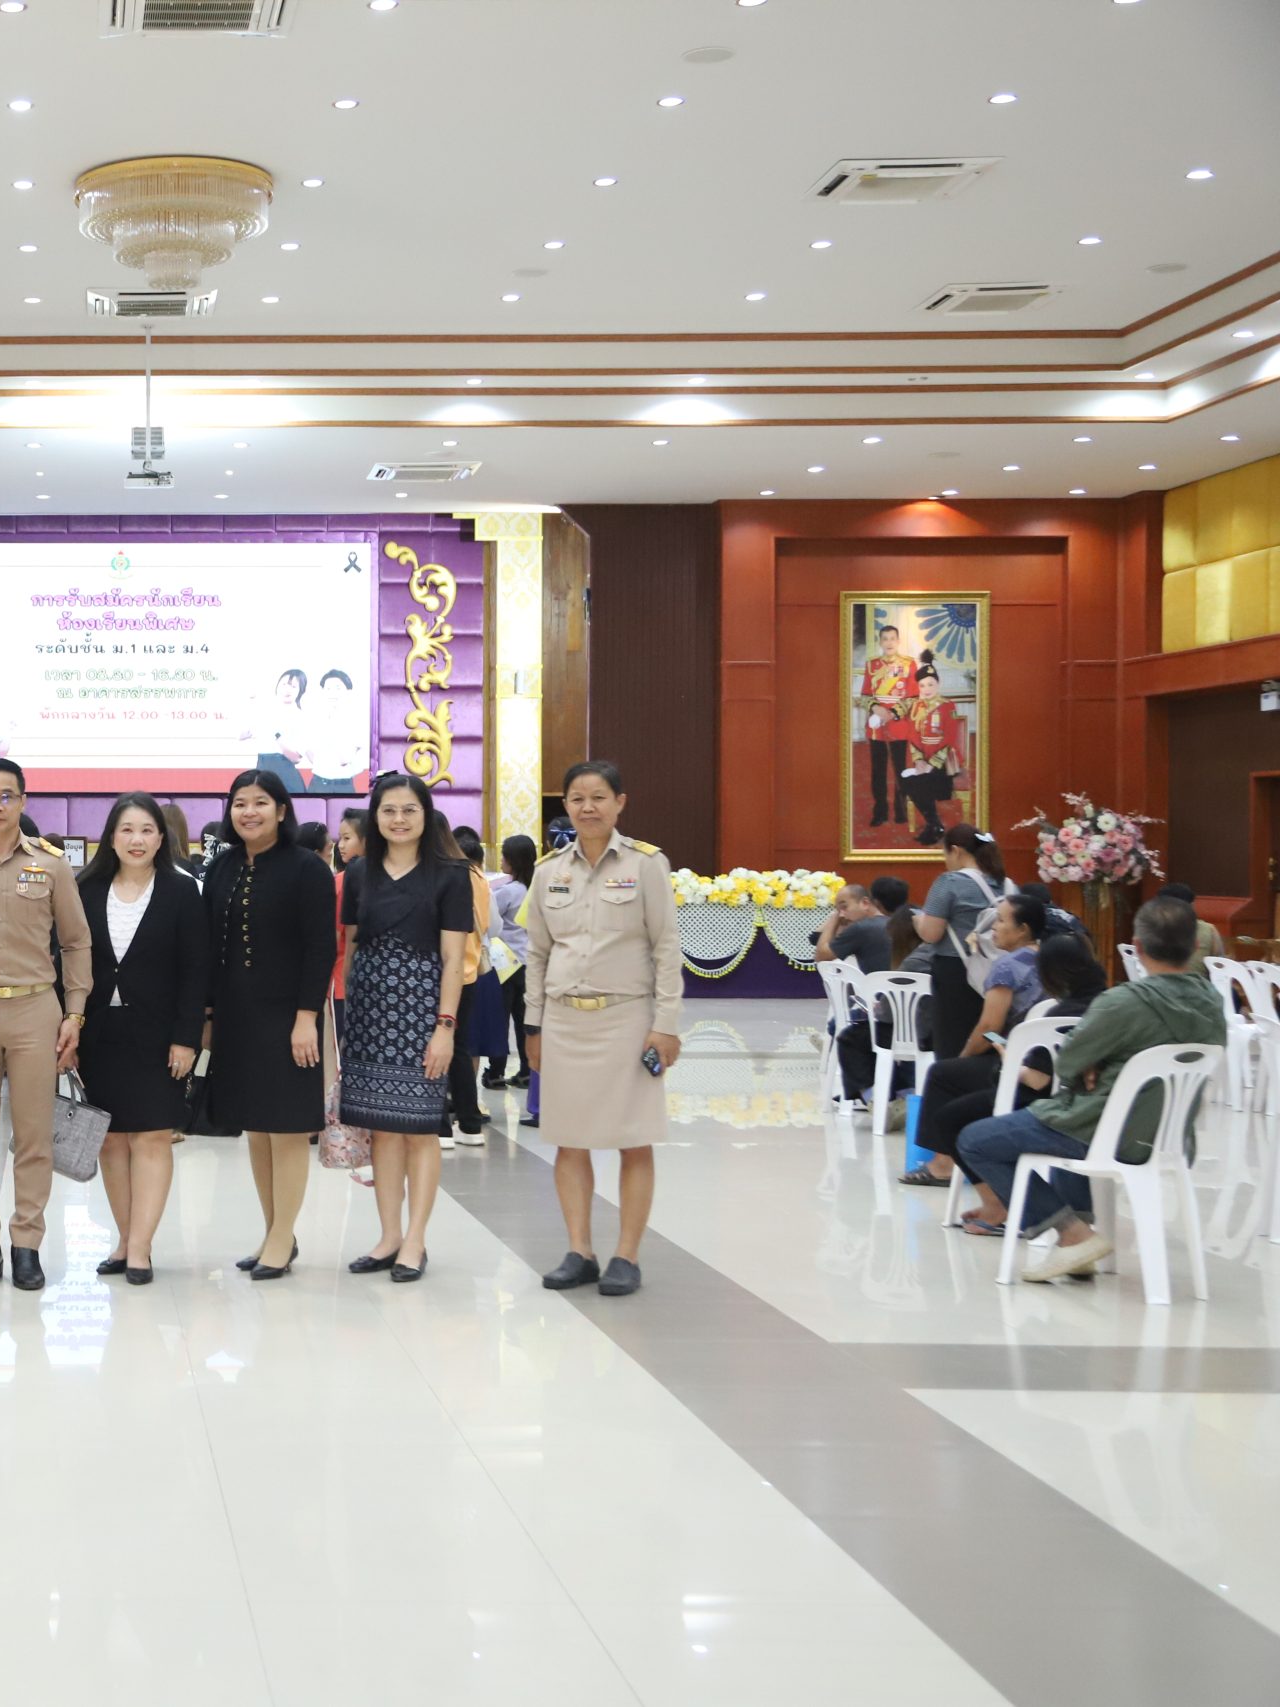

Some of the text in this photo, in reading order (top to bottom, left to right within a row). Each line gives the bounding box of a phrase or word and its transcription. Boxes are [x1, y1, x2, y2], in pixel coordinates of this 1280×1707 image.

[30, 587, 221, 607] การรับสมัครนักเรียน
[57, 611, 195, 630] ห้องเรียนพิเศษ
[35, 632, 210, 654] ระดับชั้น ม.1 และ ม.4
[39, 706, 116, 720] พักกลางวัน
[122, 711, 159, 720] 12.00
